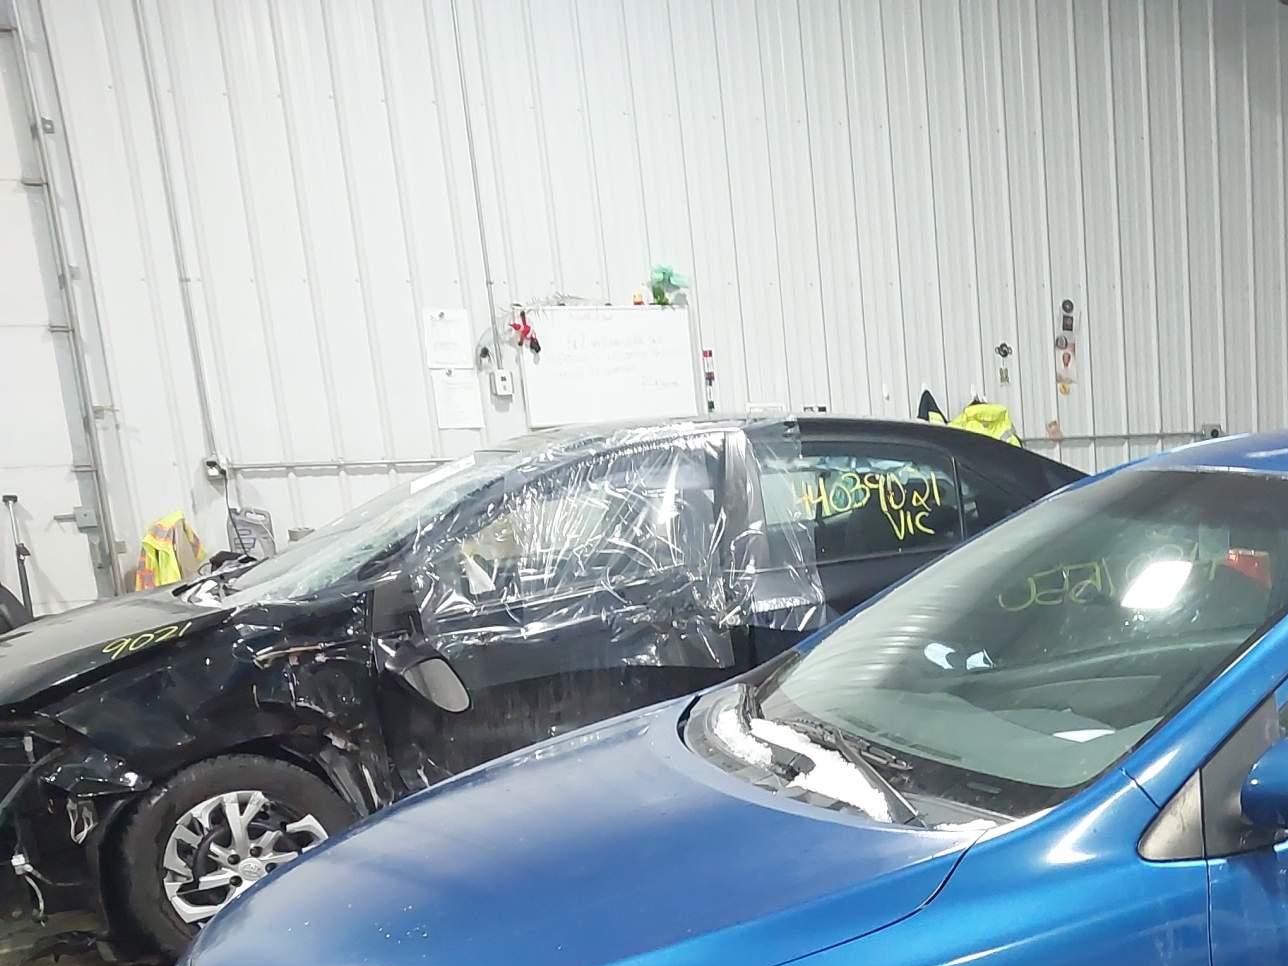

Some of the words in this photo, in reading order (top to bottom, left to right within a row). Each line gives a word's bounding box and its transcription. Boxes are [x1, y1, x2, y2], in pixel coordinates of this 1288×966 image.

[792, 466, 941, 516] 44039021
[886, 510, 936, 540] VIC
[102, 621, 192, 660] 9021
